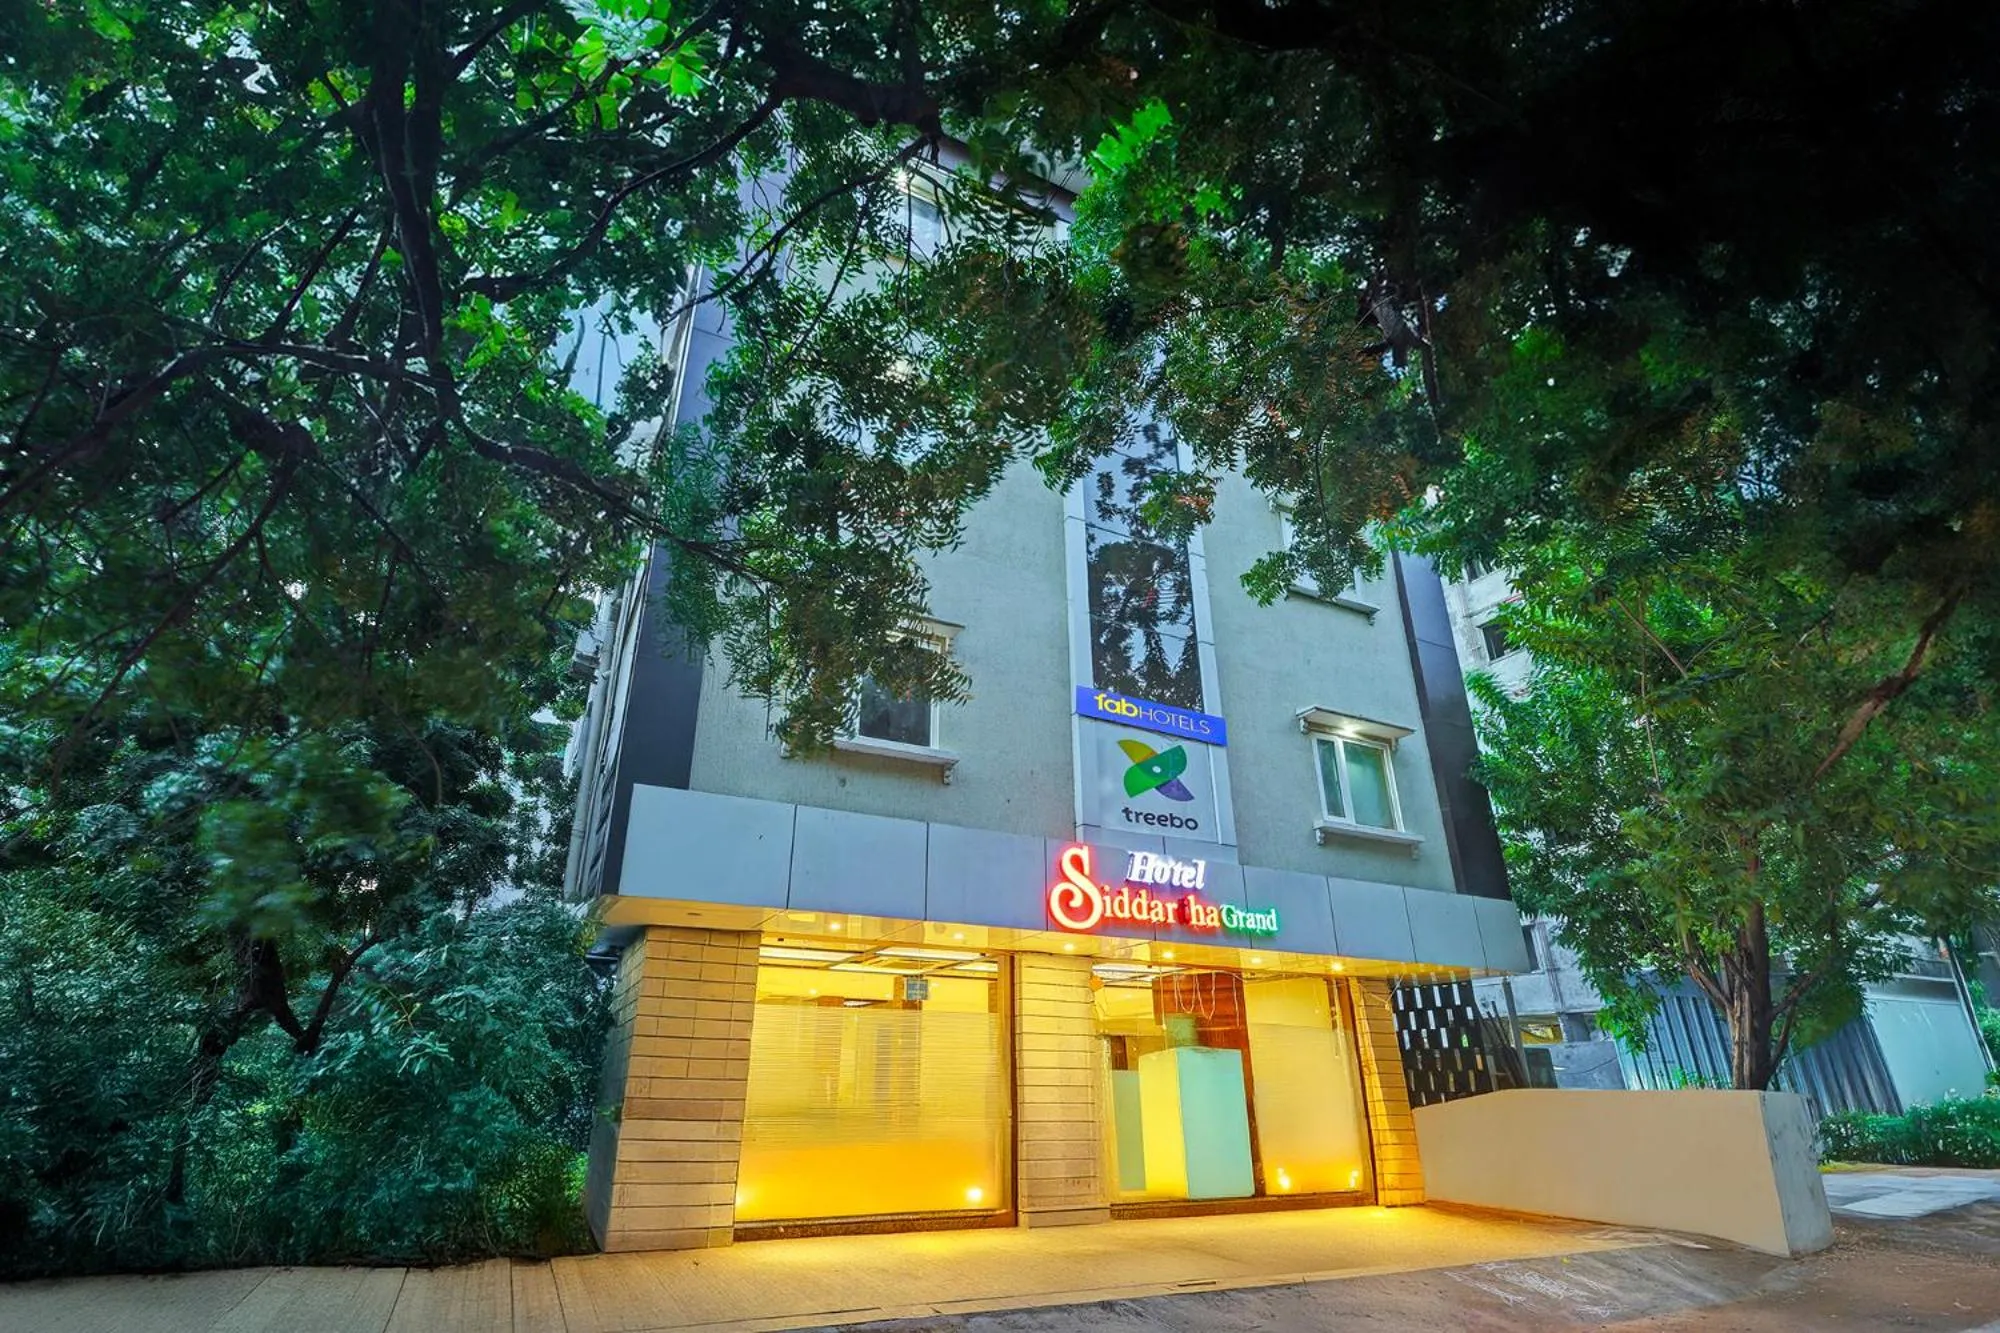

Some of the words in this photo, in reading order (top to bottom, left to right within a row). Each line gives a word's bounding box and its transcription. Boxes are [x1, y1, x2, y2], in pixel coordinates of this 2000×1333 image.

[1121, 807, 1199, 831] treebo
[1126, 851, 1206, 889] Hotel
[1221, 905, 1278, 931] Grand
